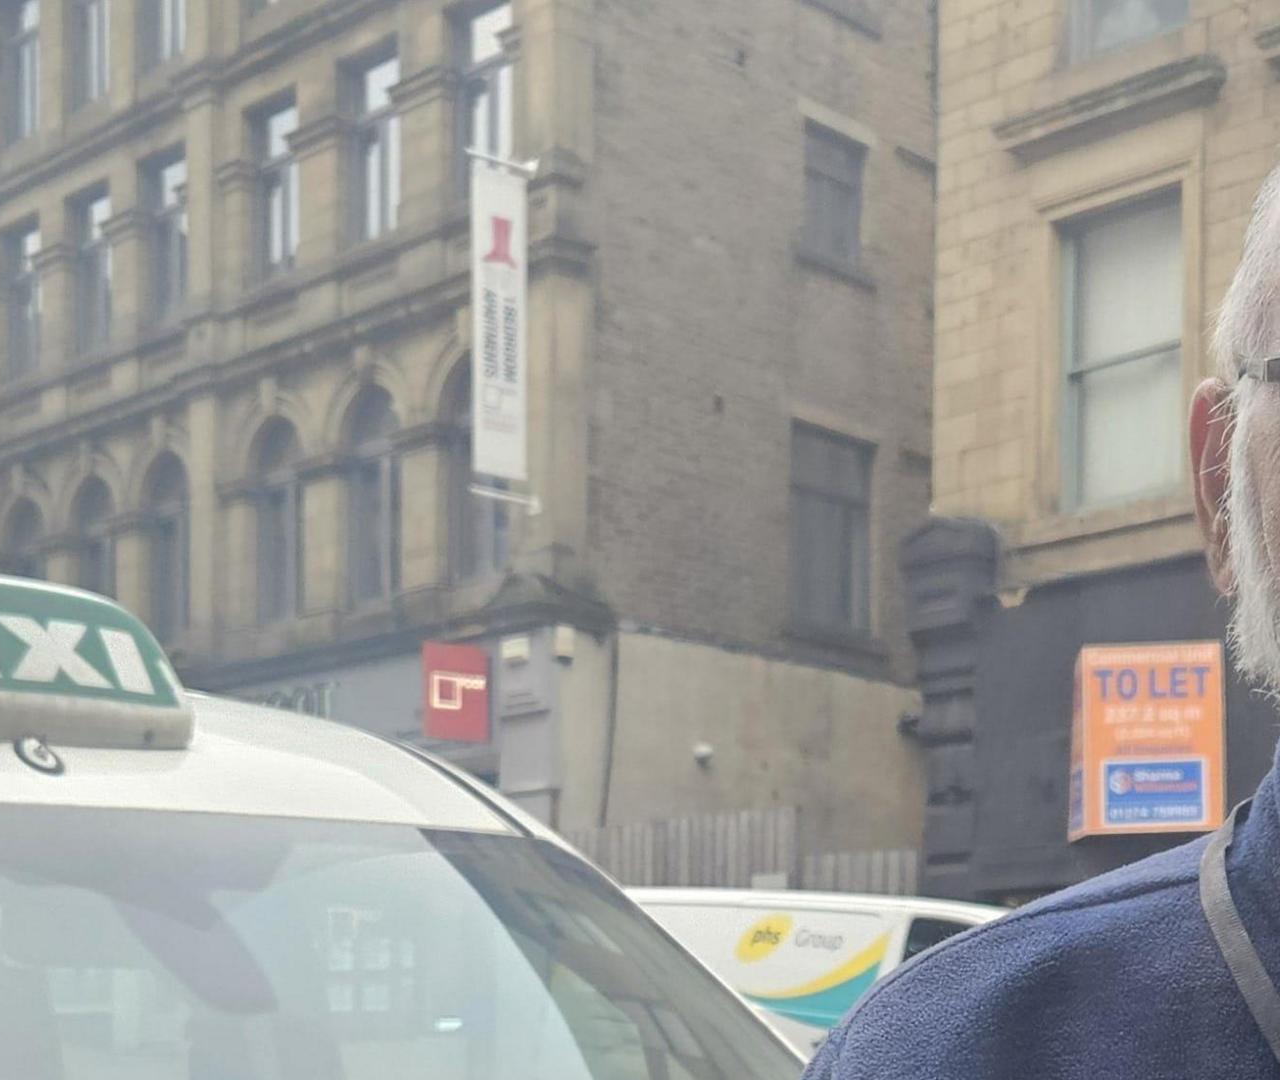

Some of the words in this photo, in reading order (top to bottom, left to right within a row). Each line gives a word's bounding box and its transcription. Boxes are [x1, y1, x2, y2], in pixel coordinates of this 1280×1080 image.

[1093, 669, 1138, 701] TO
[1149, 666, 1211, 699] LET
[751, 926, 781, 947] phs
[795, 928, 844, 951] Group
